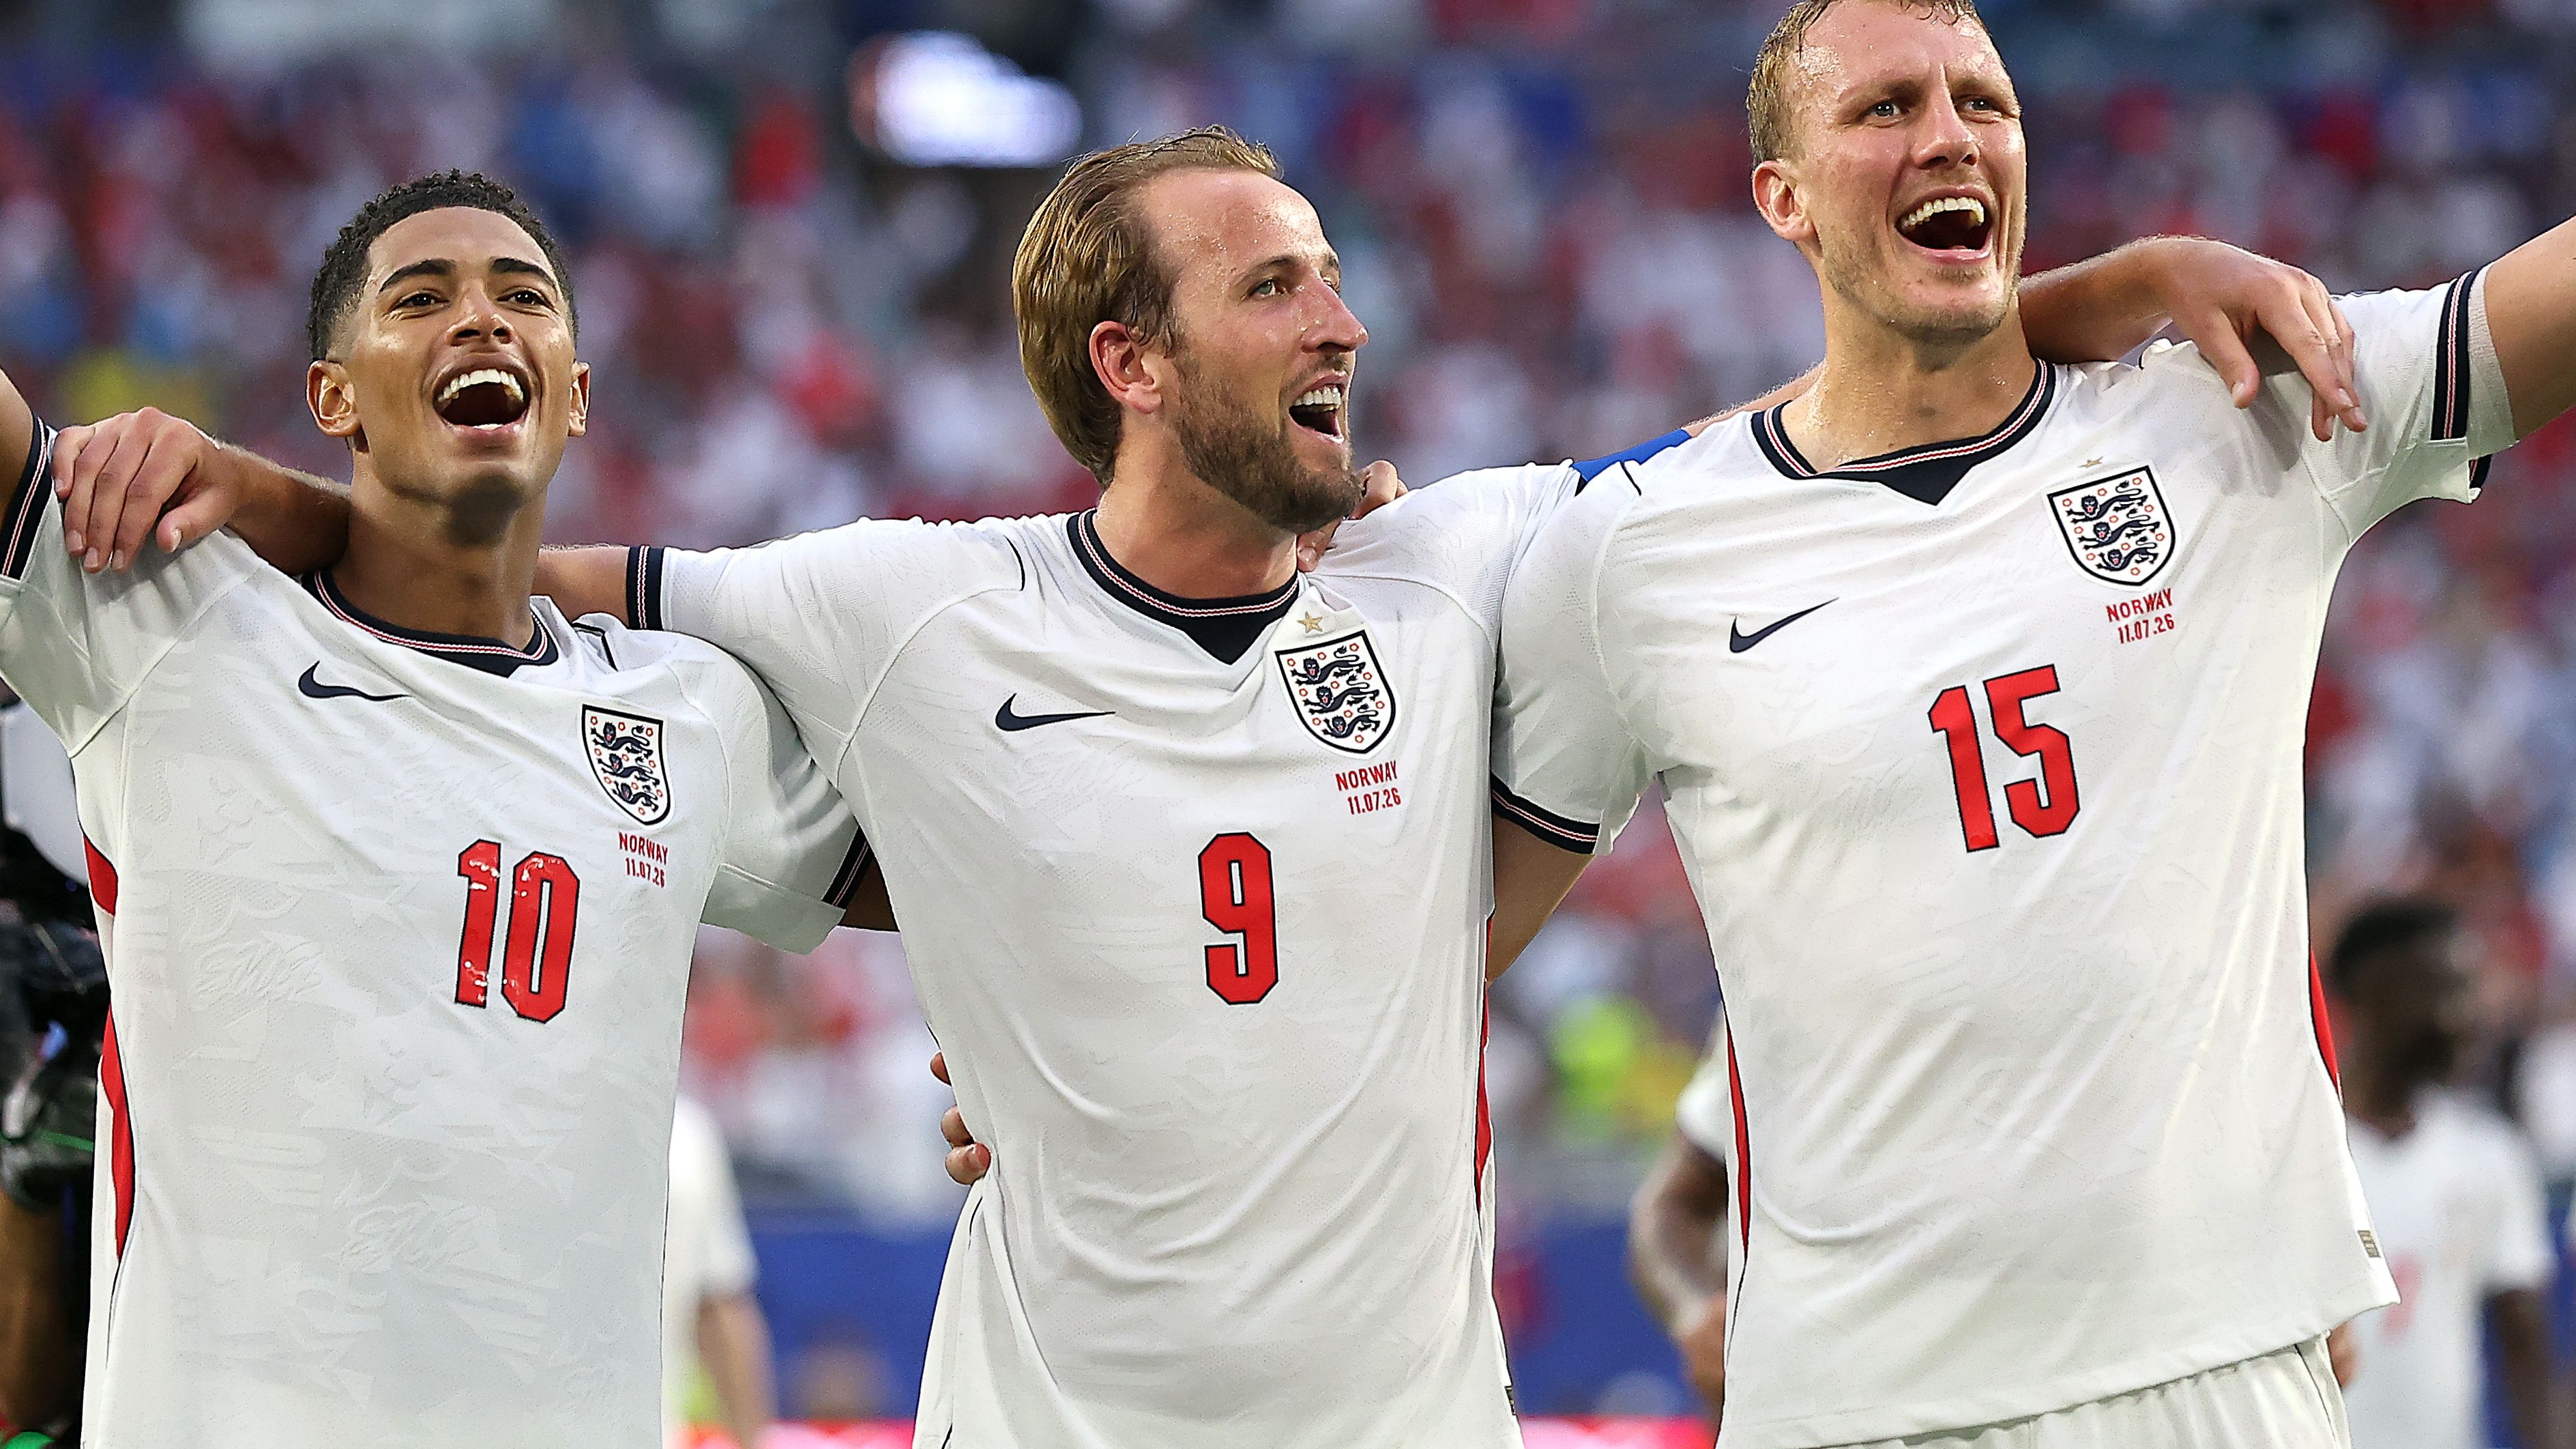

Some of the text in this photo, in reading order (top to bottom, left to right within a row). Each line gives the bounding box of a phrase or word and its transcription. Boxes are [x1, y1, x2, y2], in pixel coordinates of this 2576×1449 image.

[2105, 588, 2173, 623] NORWAY
[2118, 613, 2175, 644] 11.07.26
[1335, 760, 1398, 791] NORWAY
[1928, 664, 2081, 853] 15
[1347, 787, 1401, 815] 11.07.26
[619, 832, 669, 866] NORWAY
[626, 858, 665, 888] 11.07.26
[454, 839, 581, 1024] 10
[1198, 832, 1279, 1006] 9
